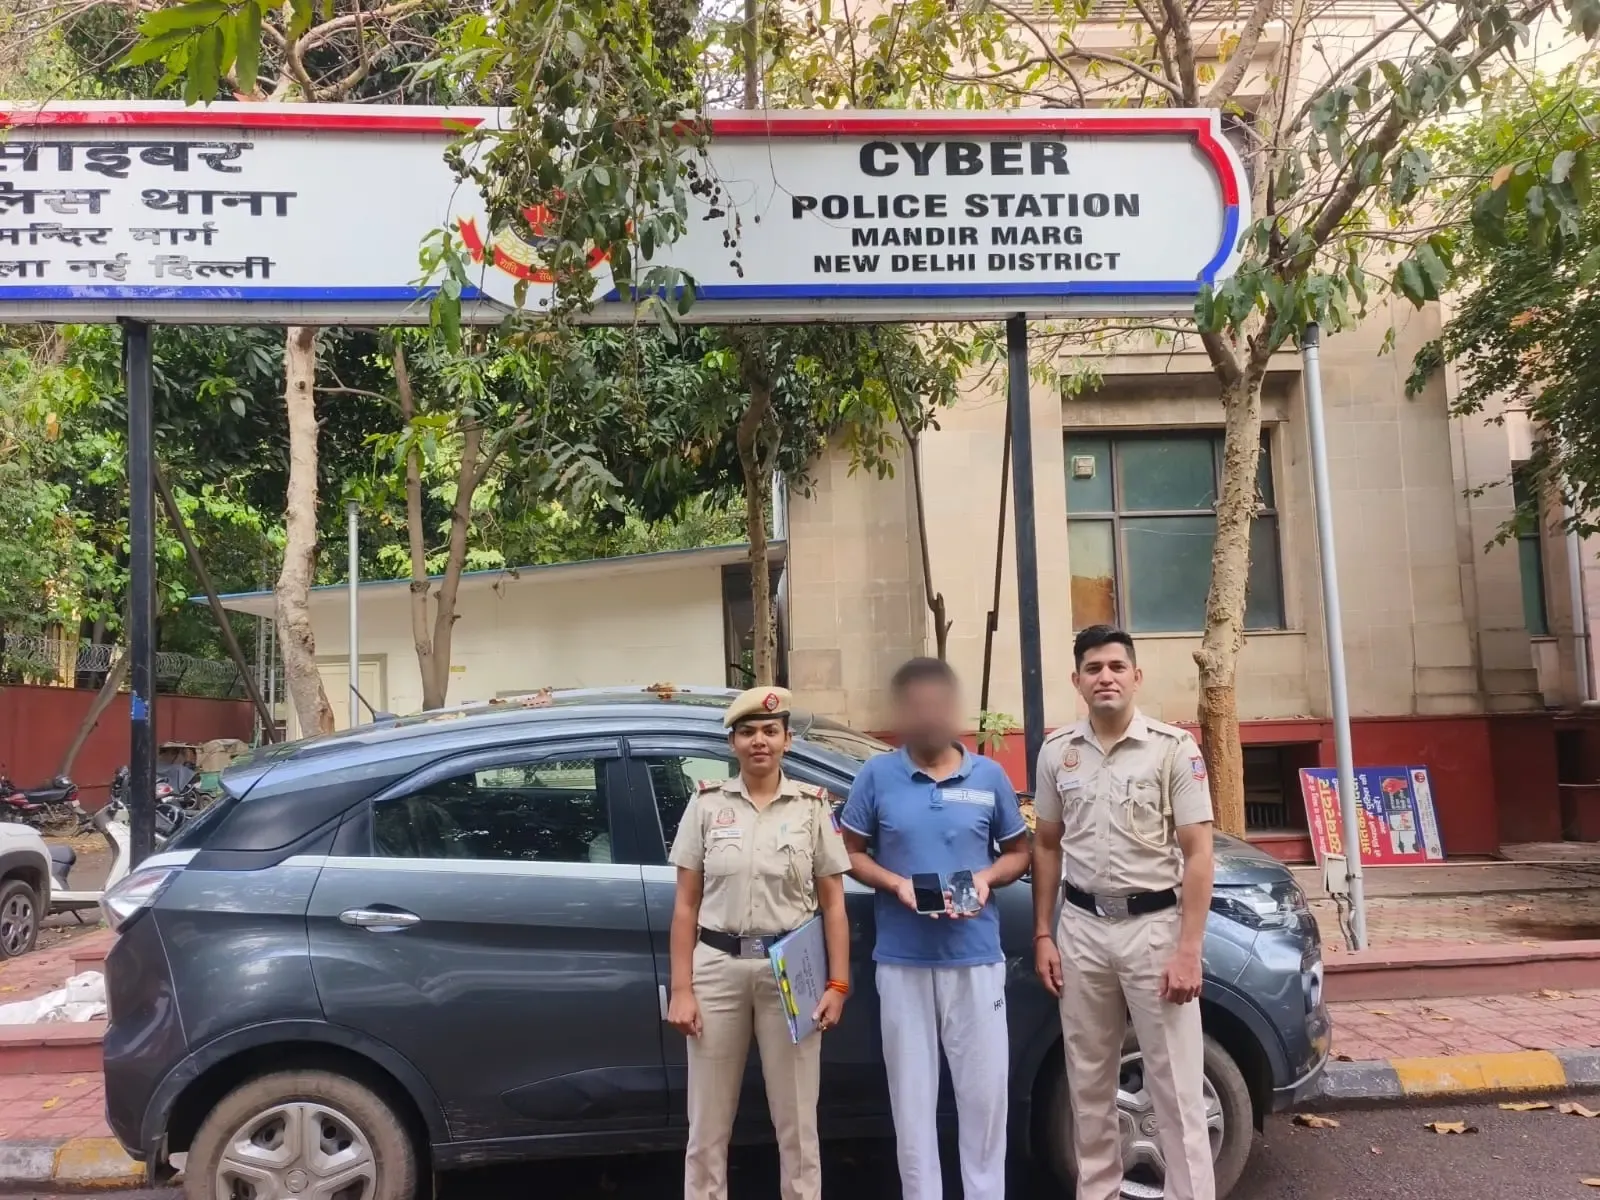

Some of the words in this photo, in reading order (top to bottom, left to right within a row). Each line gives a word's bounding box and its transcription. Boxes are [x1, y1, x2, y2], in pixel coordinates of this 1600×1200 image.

[859, 142, 1070, 177] CYBER
[141, 188, 297, 217] थाना
[792, 195, 947, 219] POLICE
[965, 193, 1140, 218] STATION
[129, 221, 219, 246] मार्ग
[852, 227, 978, 246] MANDIR
[992, 227, 1082, 245] MARG
[66, 252, 131, 282] नई
[148, 254, 276, 280] दिल्ली
[814, 255, 880, 272] NEW
[892, 254, 975, 272] DELHI
[989, 253, 1120, 270] DISTRICT
[1317, 777, 1342, 853] खबरदार
